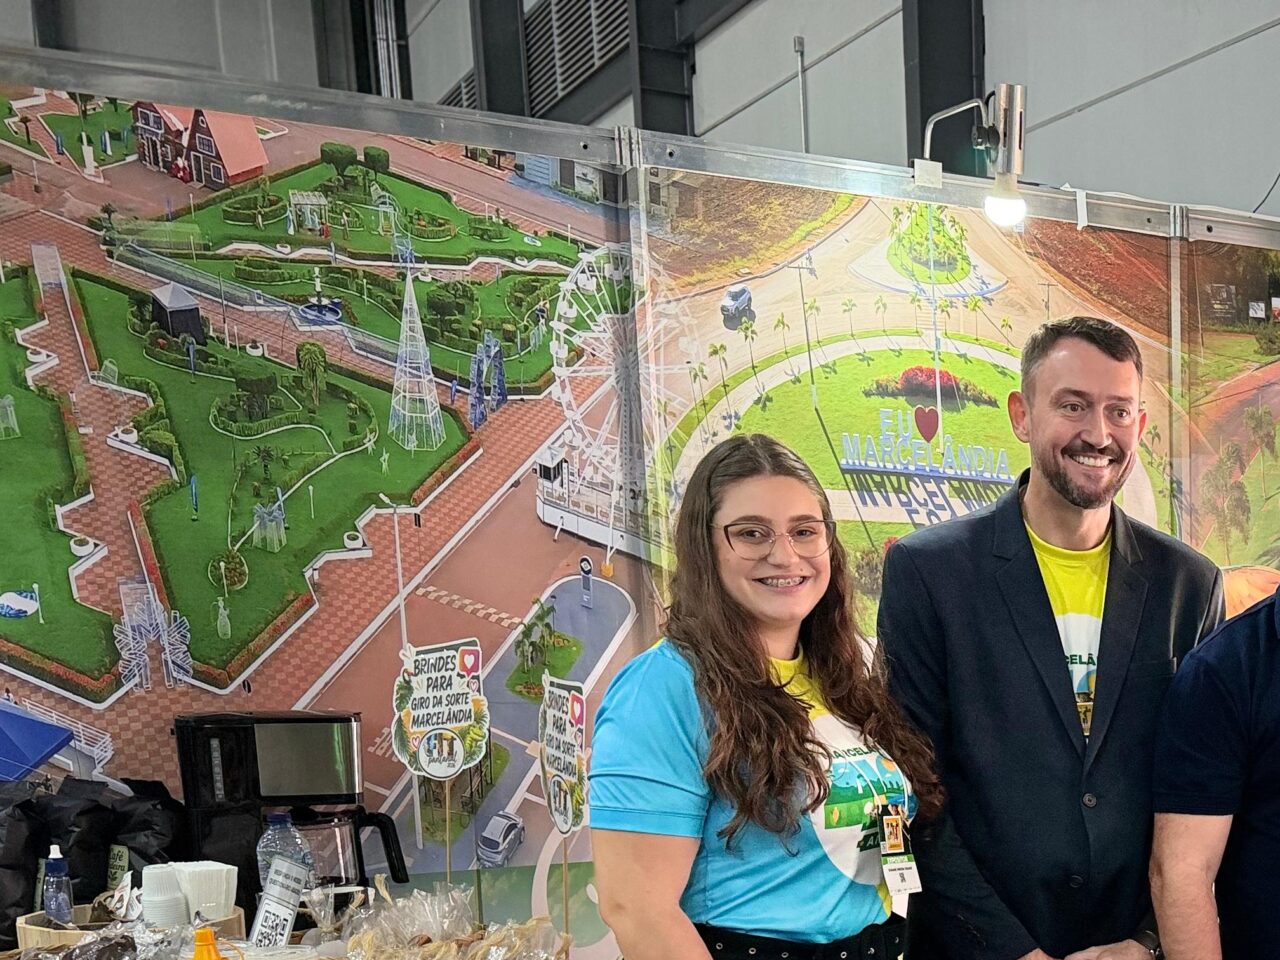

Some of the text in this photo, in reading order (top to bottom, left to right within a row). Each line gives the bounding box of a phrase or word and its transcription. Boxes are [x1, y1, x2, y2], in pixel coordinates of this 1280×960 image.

[879, 408, 913, 440] EU
[841, 432, 1012, 480] MARCELÂNDIA
[413, 654, 457, 677] BRINDES
[426, 675, 453, 692] PARA
[411, 692, 470, 712] GIRO DA SORTE
[411, 707, 473, 729] MARCELÂNDIA
